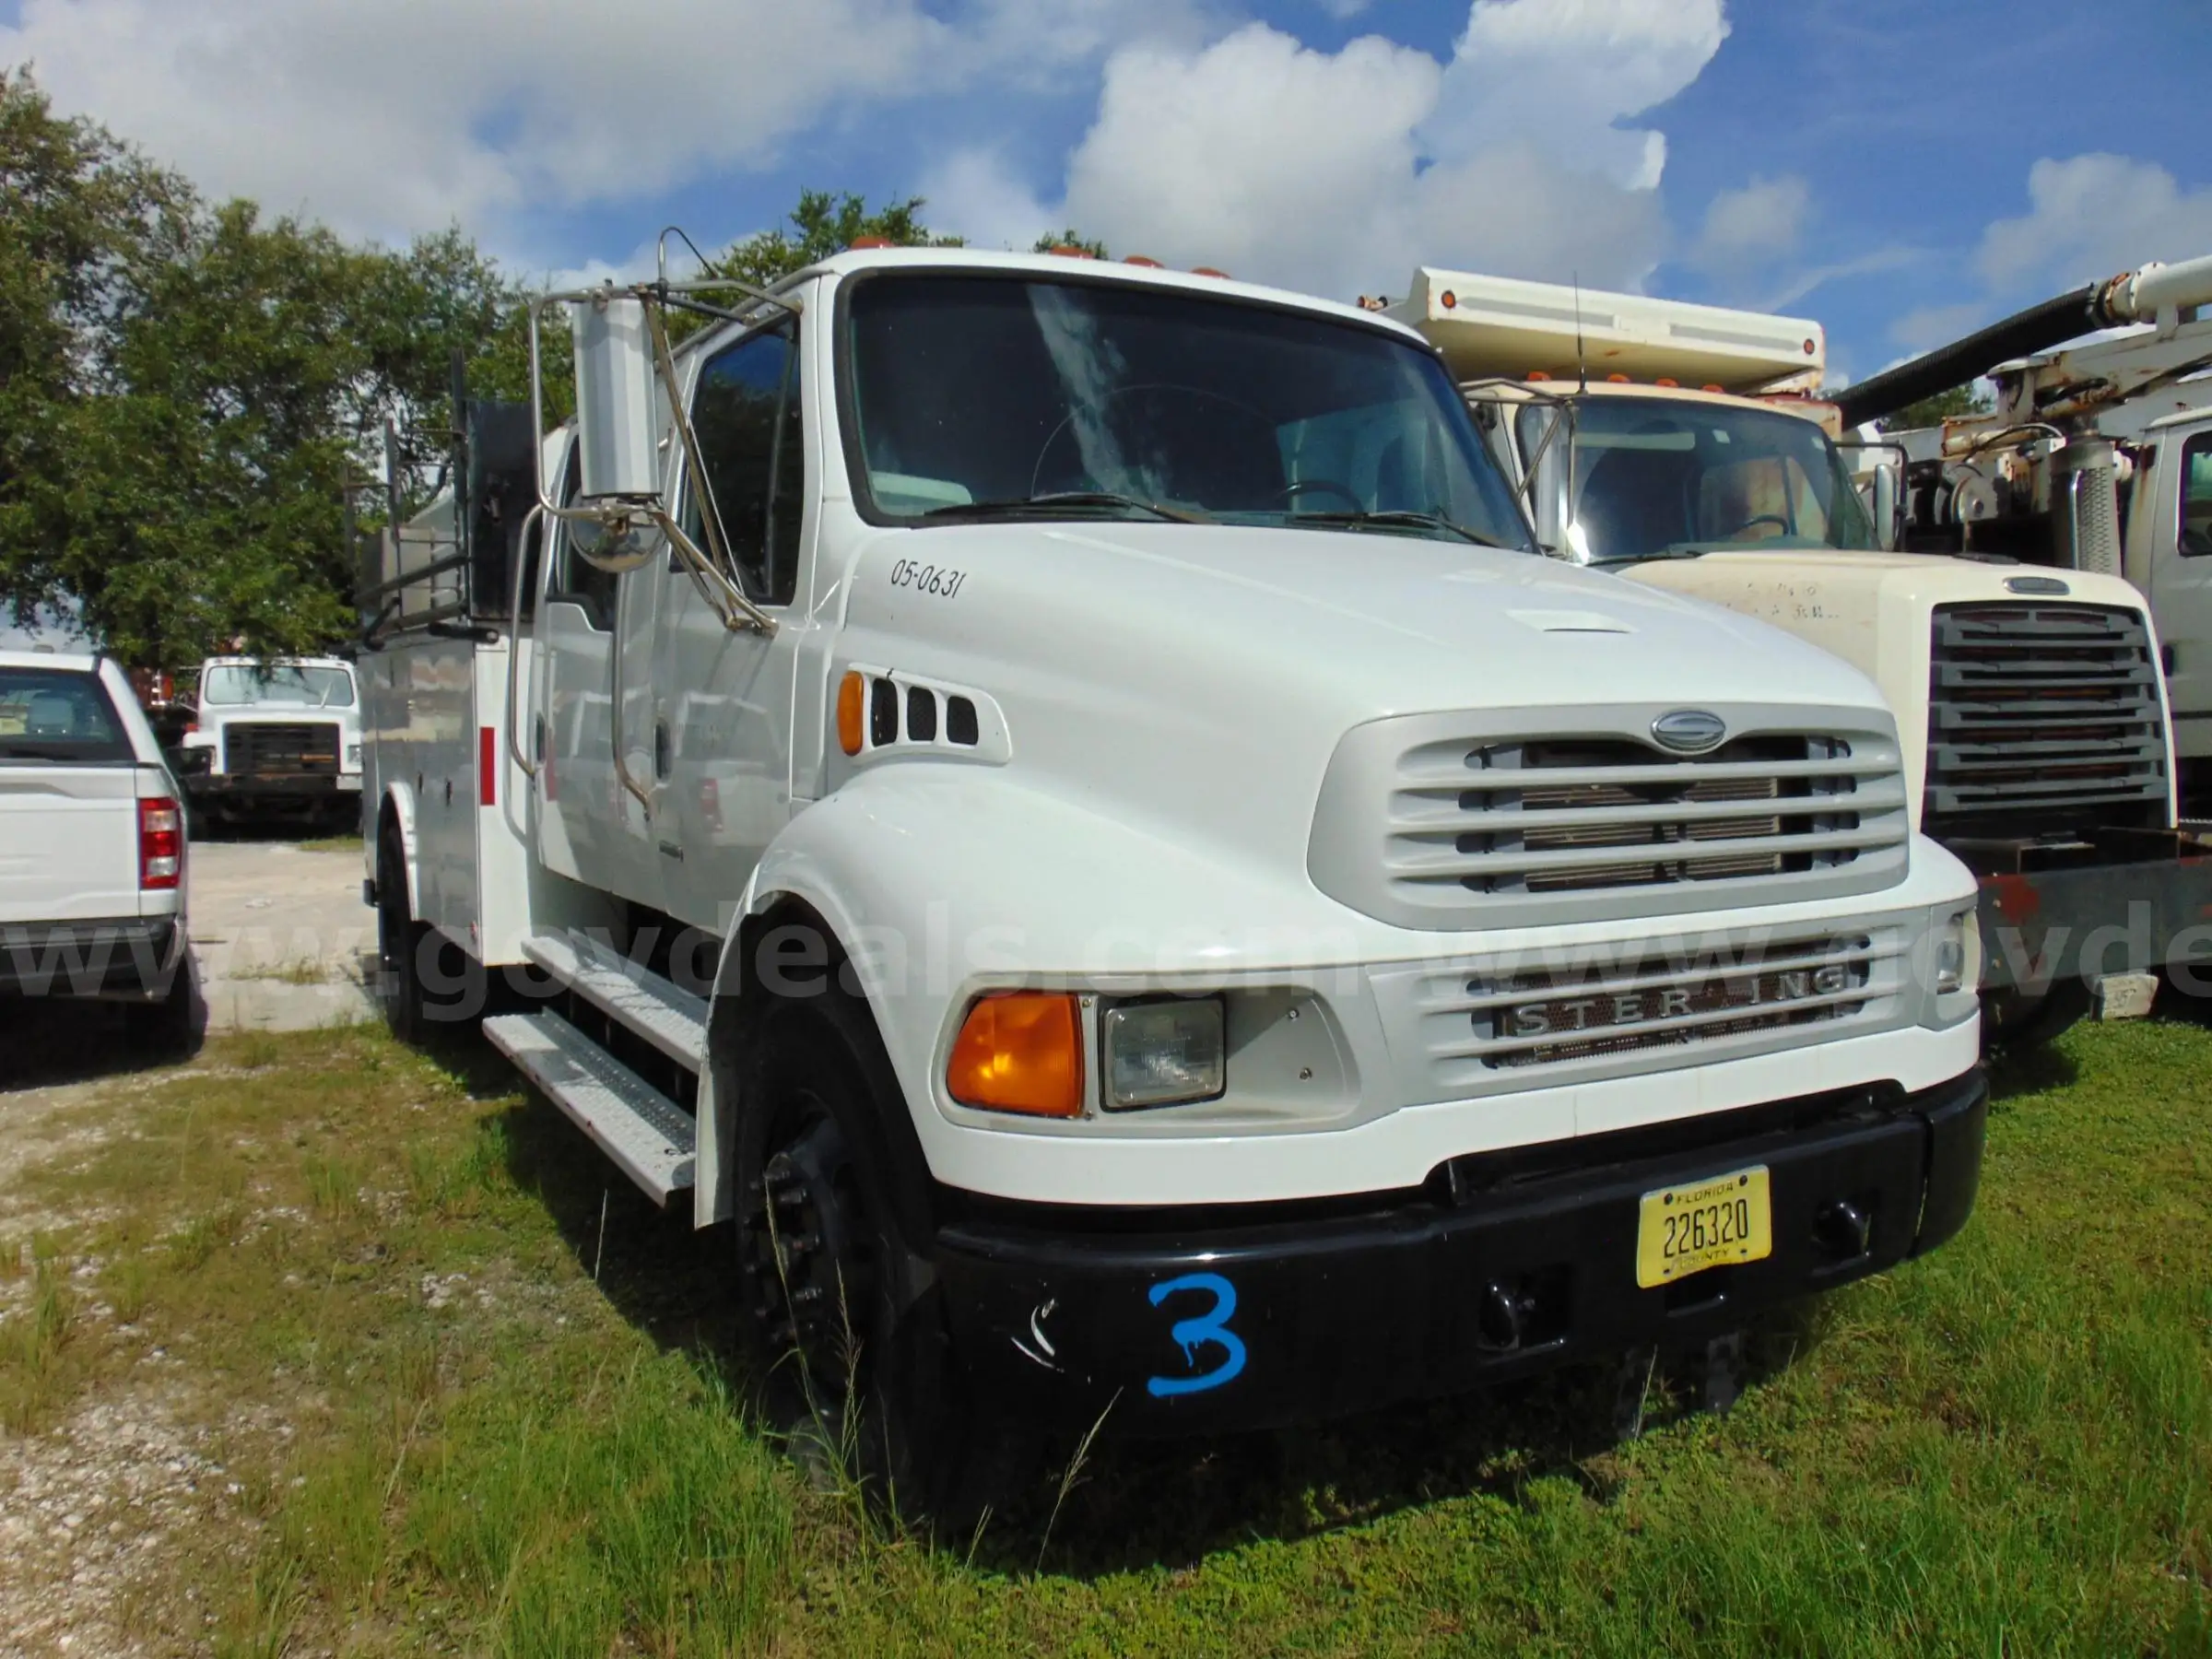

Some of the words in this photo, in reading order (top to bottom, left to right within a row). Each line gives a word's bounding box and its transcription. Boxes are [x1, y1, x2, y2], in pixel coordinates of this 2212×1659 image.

[891, 559, 967, 599] 05-0631
[1512, 966, 1843, 1038] STERING
[1677, 1182, 1734, 1205] FLORIDA
[1664, 1198, 1748, 1259] 226320
[1148, 1272, 1249, 1397] 3
